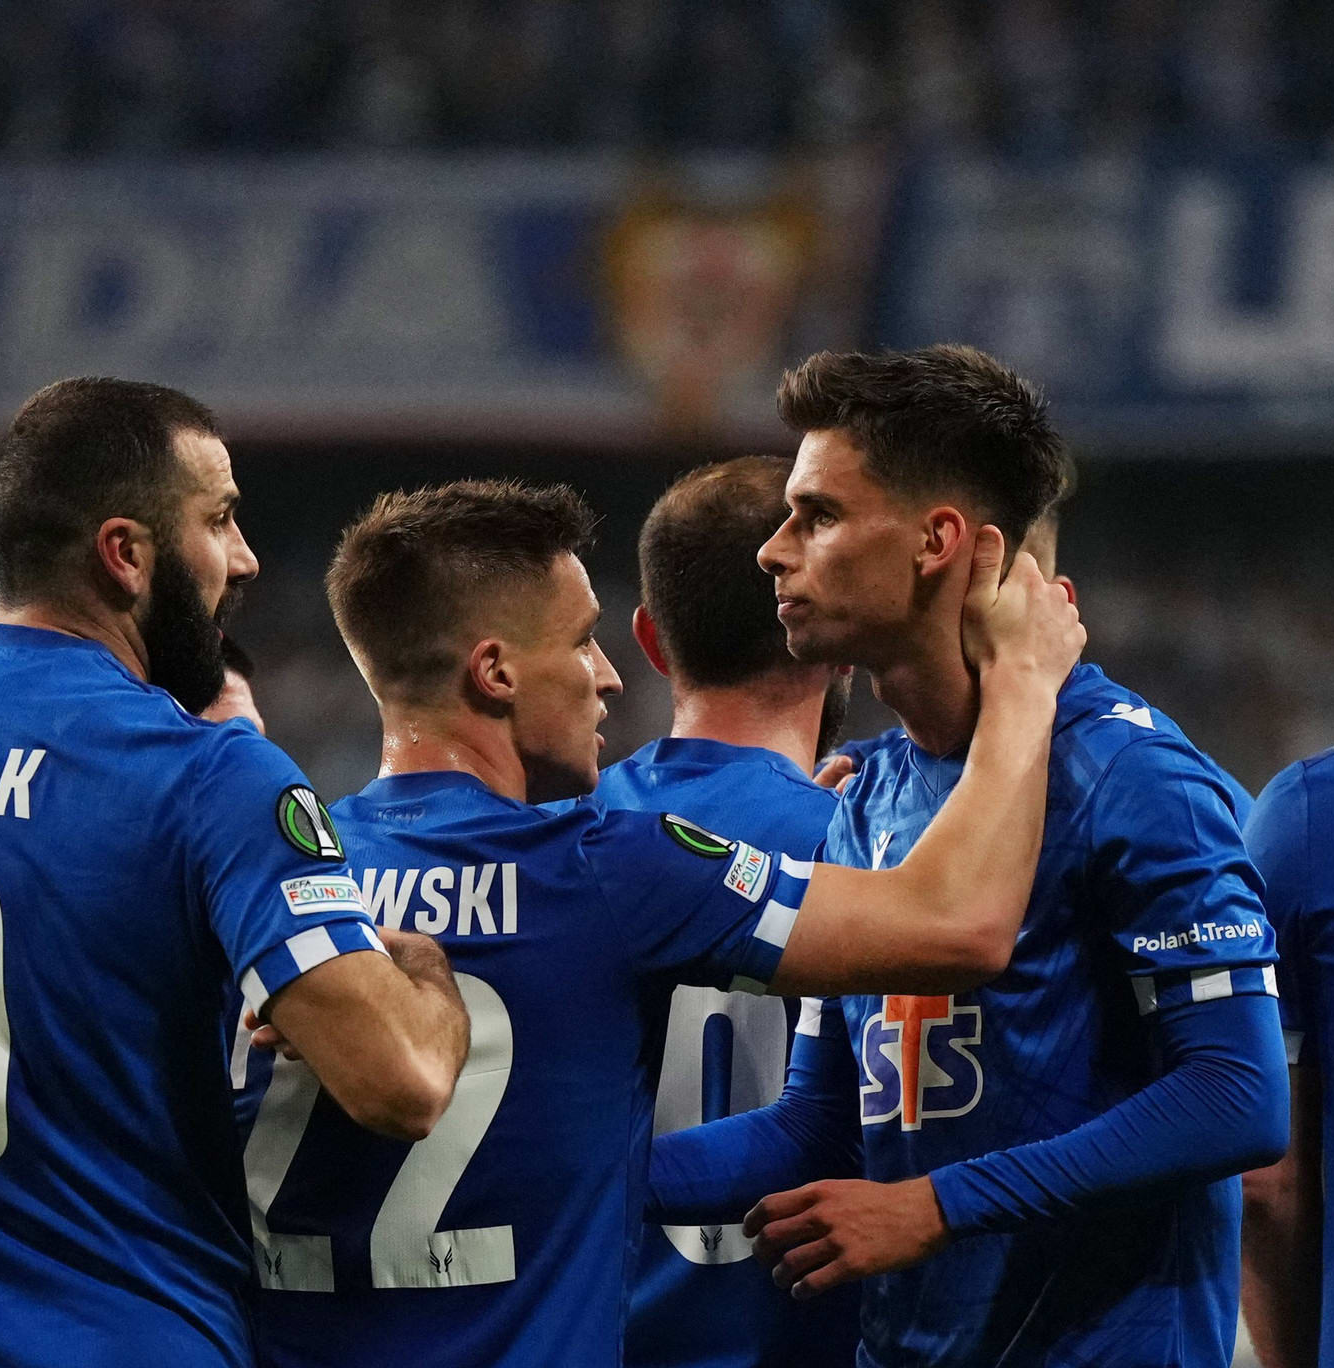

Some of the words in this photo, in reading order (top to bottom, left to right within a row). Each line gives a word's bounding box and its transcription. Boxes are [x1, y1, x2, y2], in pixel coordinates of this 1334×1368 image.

[349, 862, 518, 937] WSKI
[1133, 919, 1263, 953] Poland.Travel
[859, 994, 984, 1132] STS
